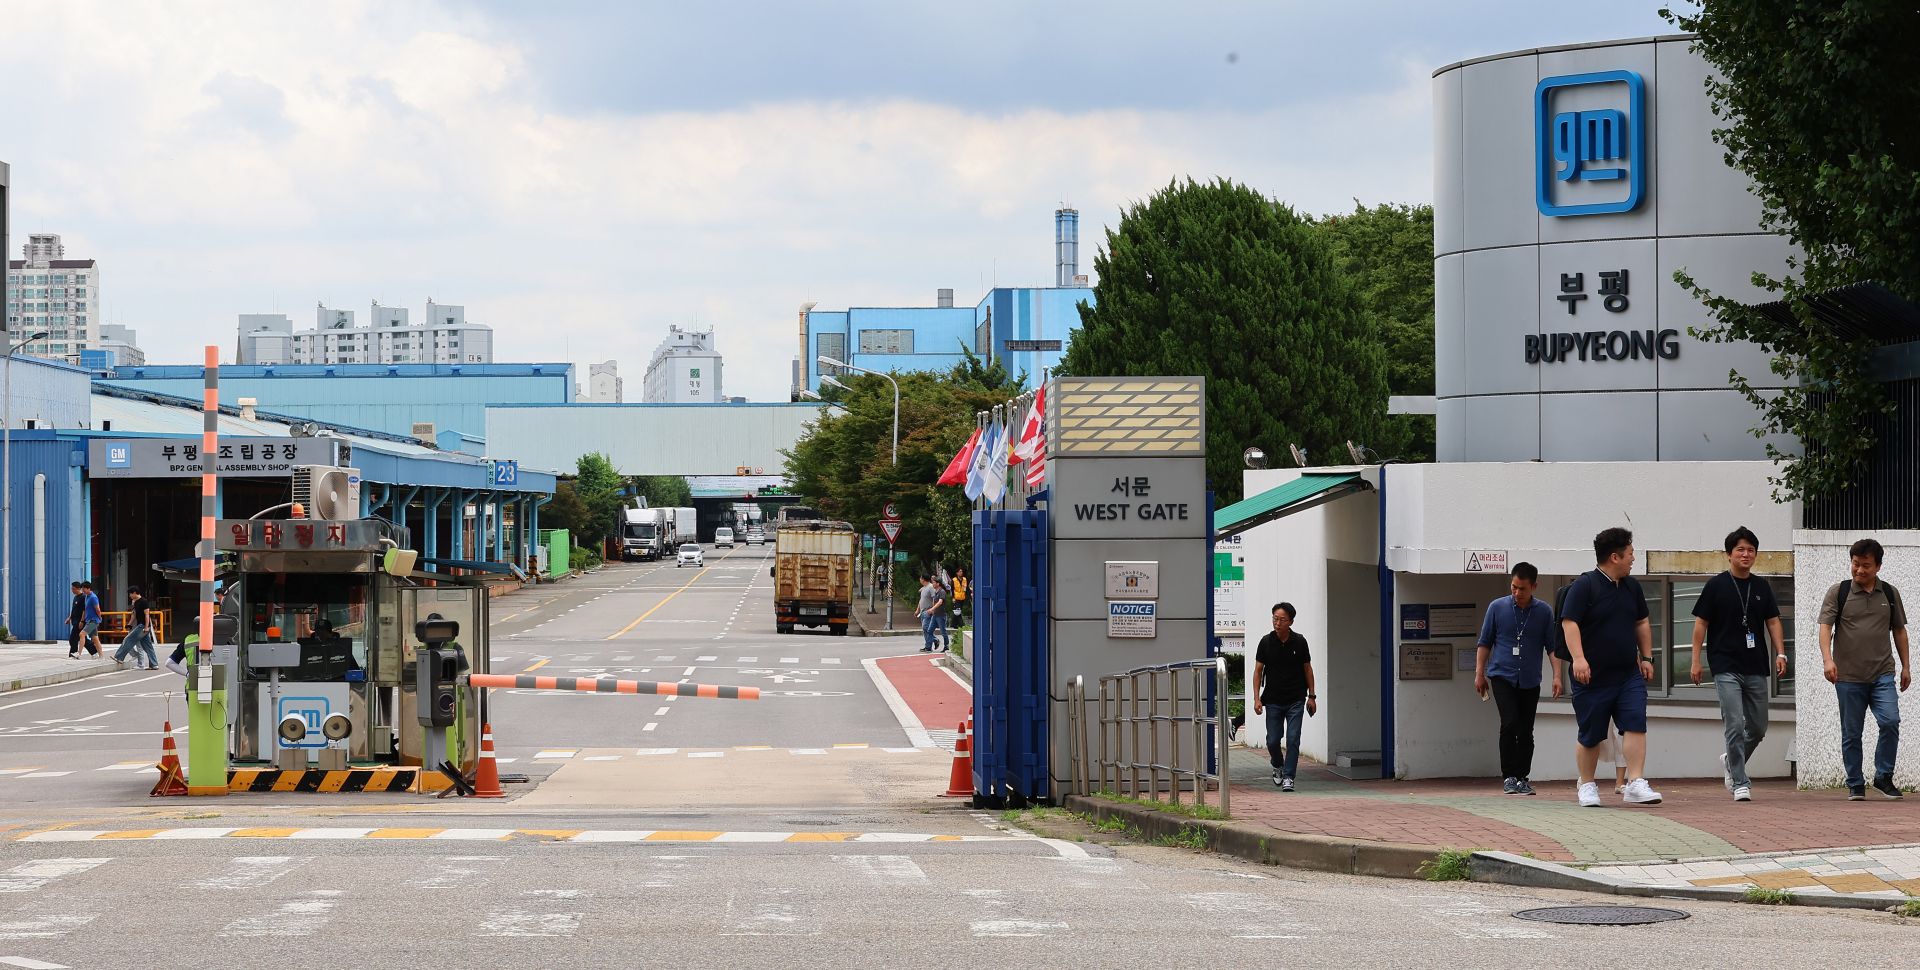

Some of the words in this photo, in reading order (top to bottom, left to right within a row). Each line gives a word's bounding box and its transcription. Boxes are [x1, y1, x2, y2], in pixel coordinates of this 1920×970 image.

[1553, 108, 1625, 181] gm
[1557, 268, 1630, 315] 부평
[1524, 329, 1680, 364] BUPYEONG
[111, 448, 126, 459] GM
[161, 444, 198, 461] 부평
[170, 464, 185, 472] BP2
[224, 463, 266, 471] ASSEMBLY
[268, 463, 290, 471] SHOP
[497, 465, 515, 482] 23
[1111, 476, 1151, 497] 서문
[1074, 503, 1130, 520] WEST
[1137, 503, 1188, 520] GATE
[1112, 604, 1153, 614] NOTICE
[288, 710, 320, 733] m
